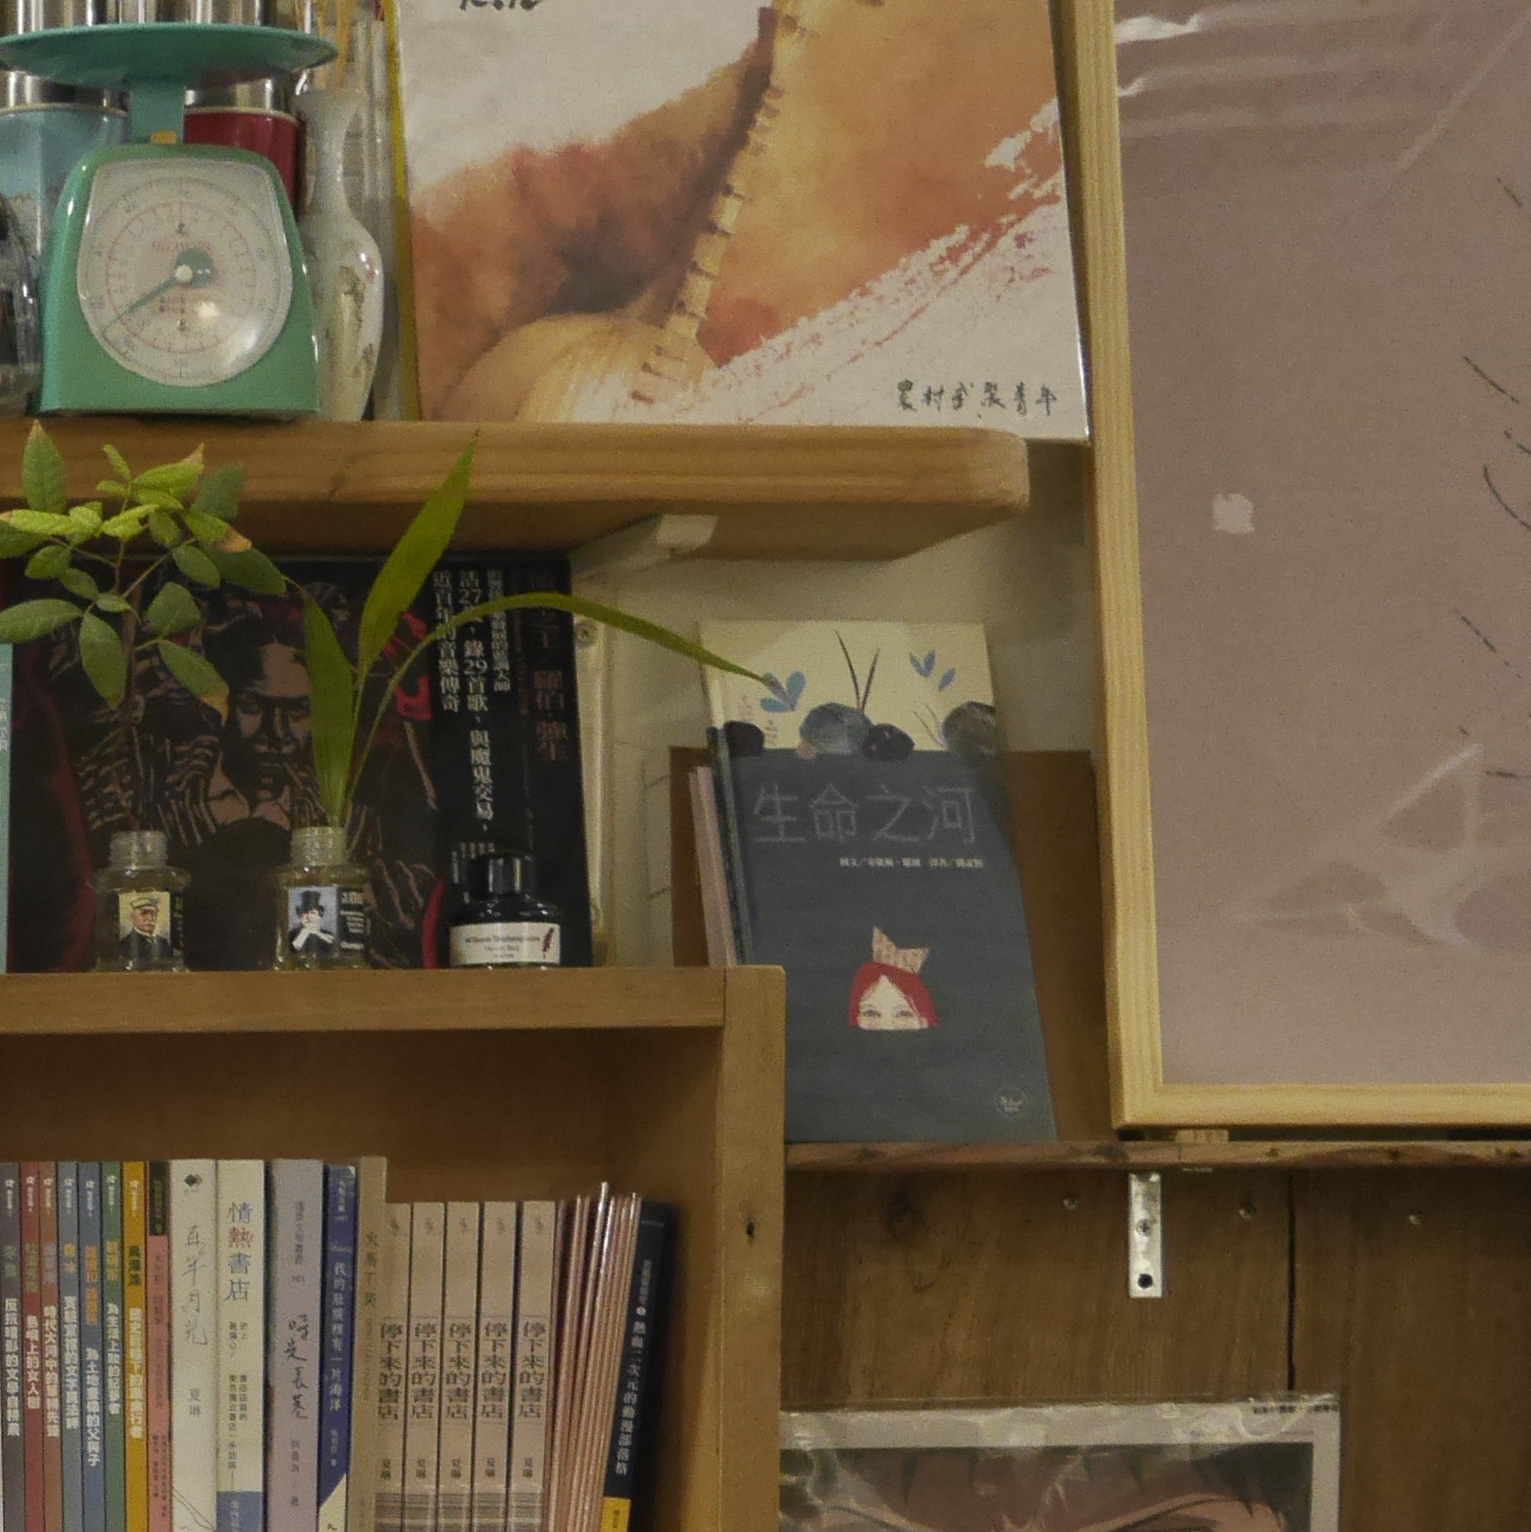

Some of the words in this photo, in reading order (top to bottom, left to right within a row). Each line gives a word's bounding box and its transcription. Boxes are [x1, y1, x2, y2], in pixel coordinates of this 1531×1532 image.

[752, 782, 976, 844] 生命之河
[226, 1201, 254, 1301] 情熱書店
[377, 1320, 403, 1421] 停下來的書店
[411, 1320, 438, 1421] 停下來的書店
[445, 1320, 472, 1421] 停下來的書店
[480, 1320, 508, 1421] 停下來的書店
[519, 1320, 547, 1421] 停下來的書店
